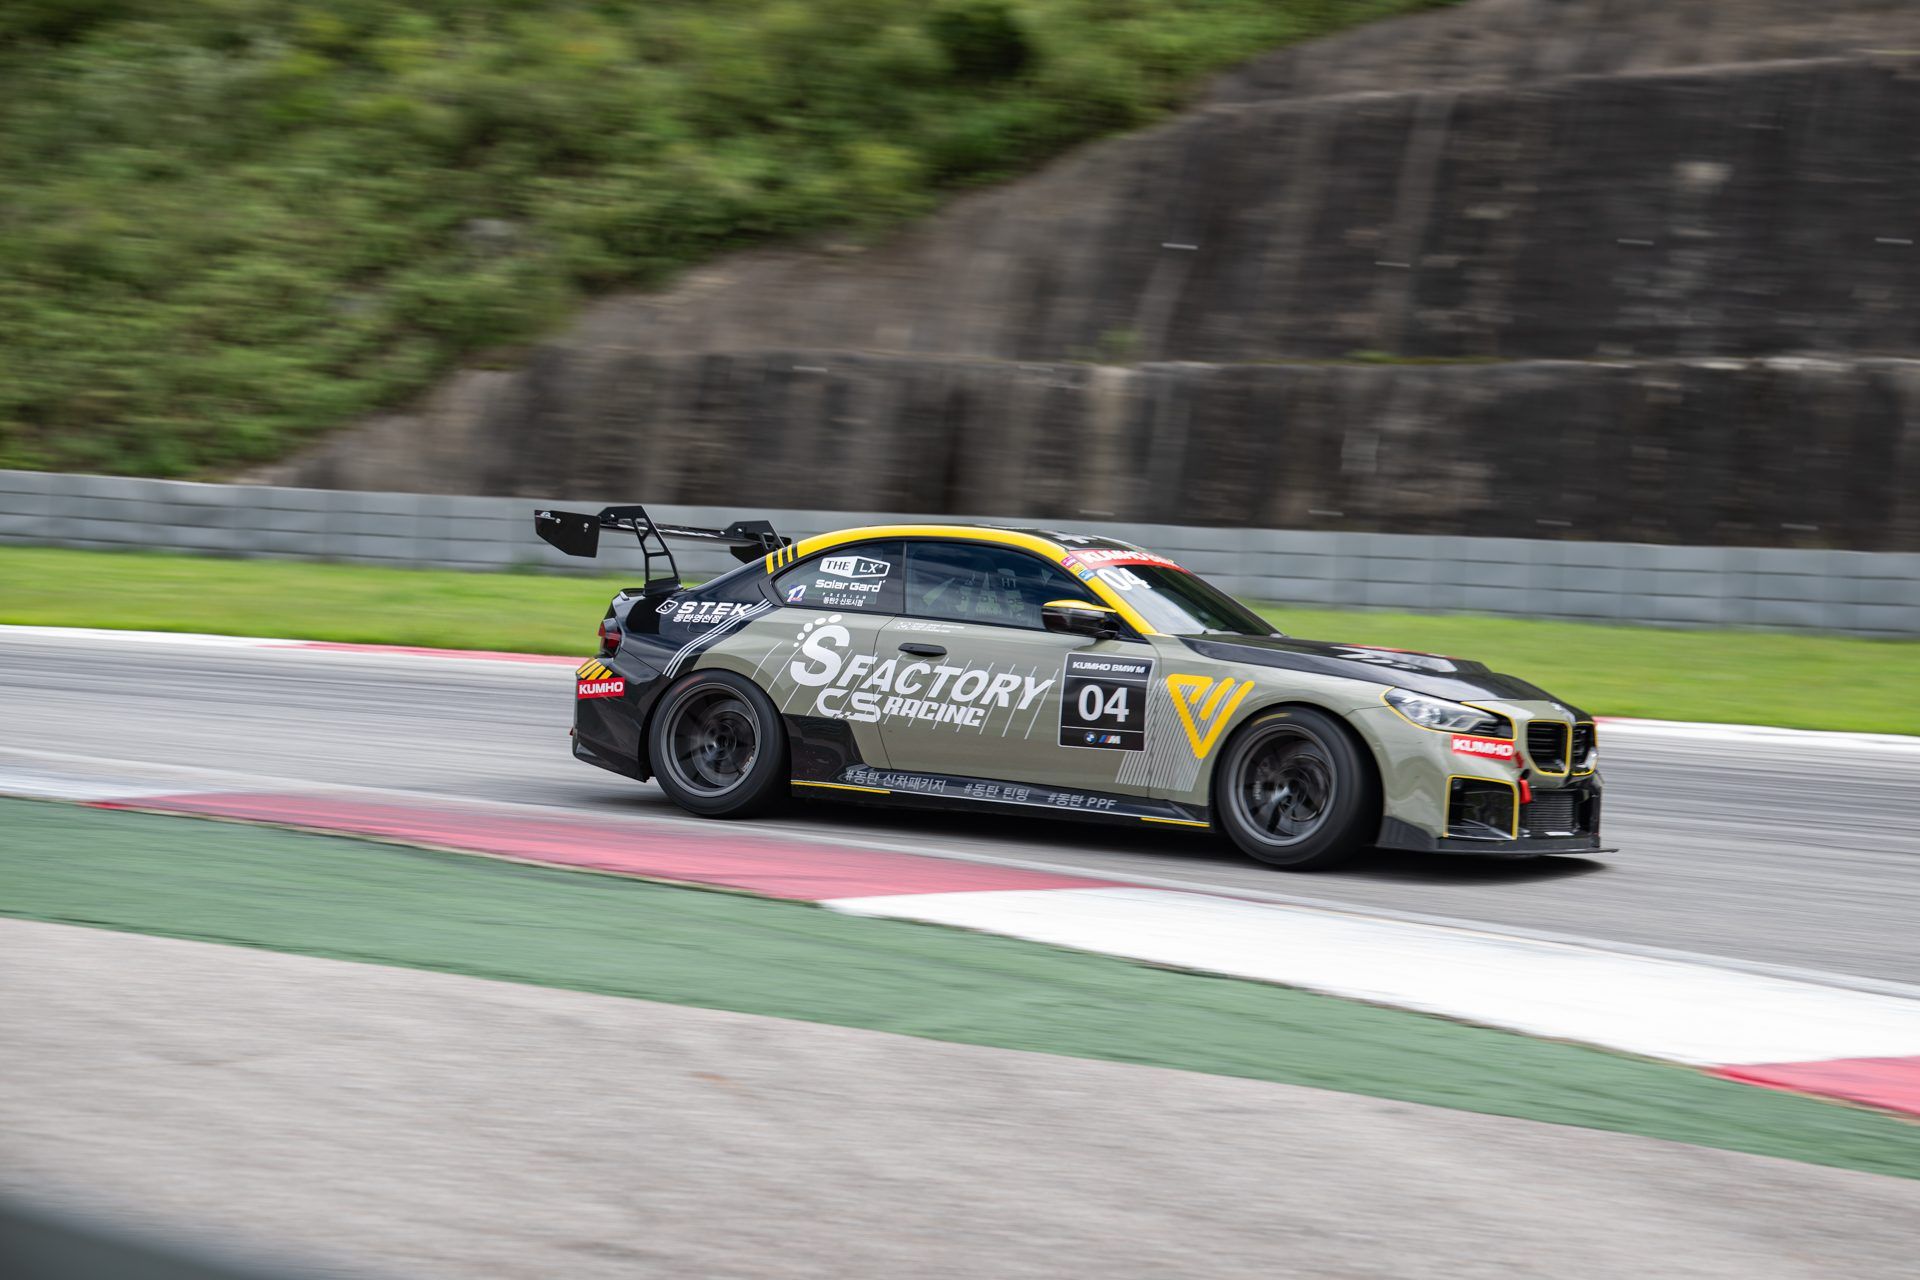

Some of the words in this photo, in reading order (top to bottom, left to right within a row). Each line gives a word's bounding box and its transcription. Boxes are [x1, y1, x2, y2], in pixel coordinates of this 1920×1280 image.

[826, 560, 851, 571] THE
[815, 579, 848, 590] Solar
[849, 580, 882, 593] Gard
[1097, 567, 1152, 591] 04
[677, 601, 752, 616] STEK
[1072, 661, 1111, 671] KUMHO
[1111, 664, 1135, 673] BMW
[1135, 665, 1146, 674] M
[579, 681, 624, 695] KUMHO
[1078, 684, 1130, 722] 04
[882, 696, 986, 727] RACING
[1453, 739, 1513, 757] KUMHO
[845, 769, 880, 786] #동탄
[882, 774, 947, 793] 신차패키지
[963, 783, 1000, 798] #동탄
[1002, 787, 1031, 802] 틴팅
[1047, 792, 1084, 807] #동탄
[1086, 797, 1118, 810] PPF
